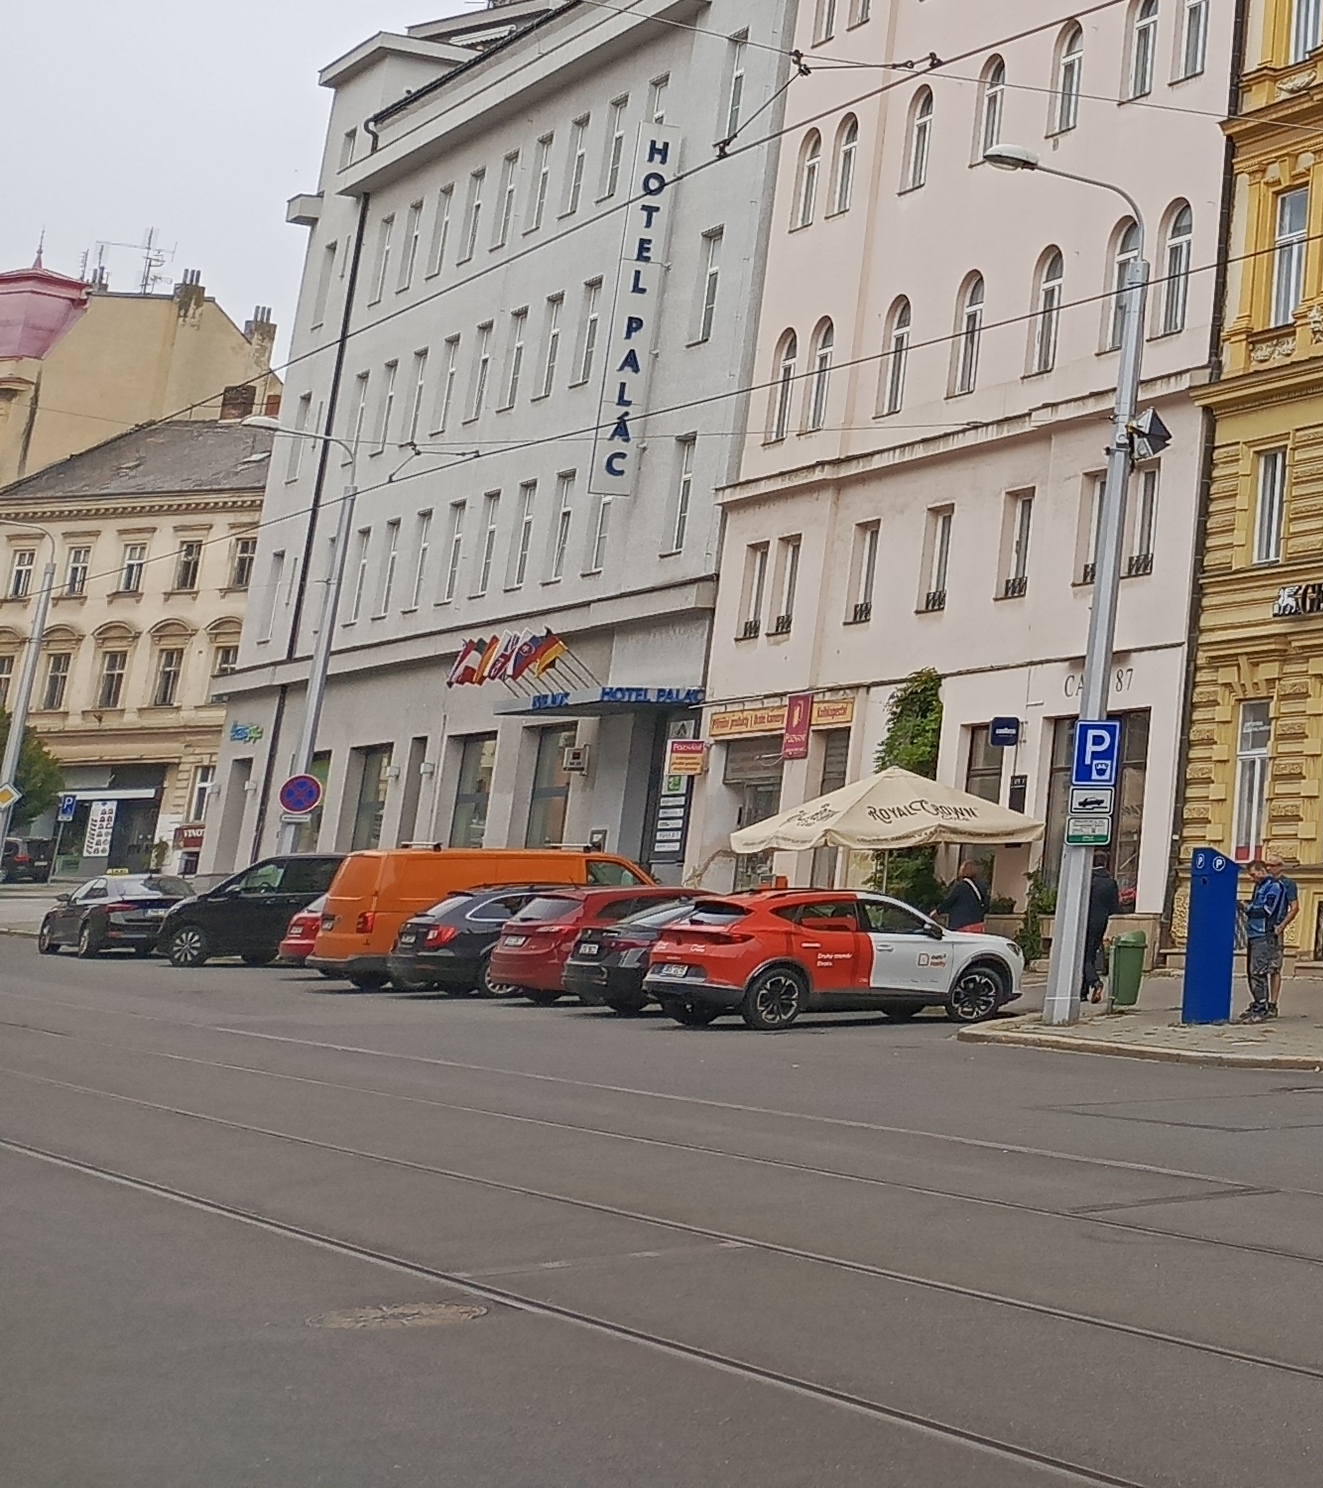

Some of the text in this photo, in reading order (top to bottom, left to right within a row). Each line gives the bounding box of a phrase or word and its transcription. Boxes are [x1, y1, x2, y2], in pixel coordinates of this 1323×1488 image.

[604, 139, 670, 477] HOTEL PALÁC
[1115, 668, 1134, 693] 87
[601, 687, 650, 703] HOTEL
[867, 805, 918, 824] ROYAL
